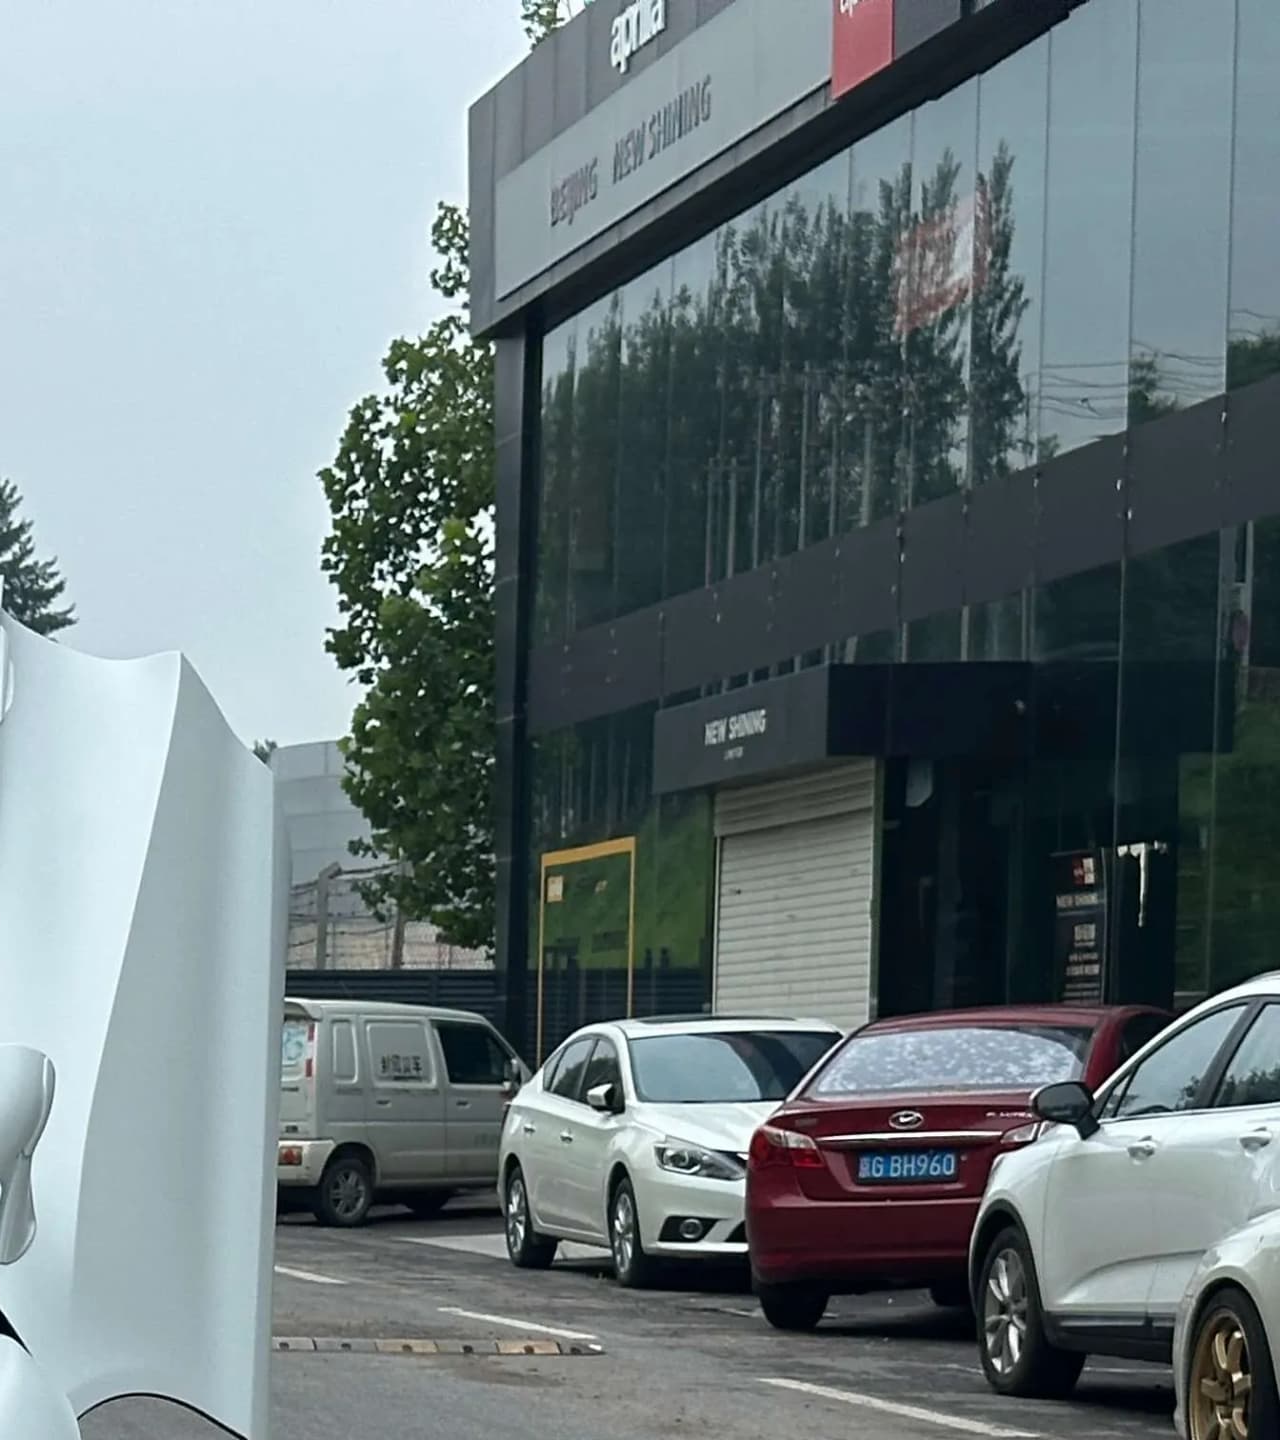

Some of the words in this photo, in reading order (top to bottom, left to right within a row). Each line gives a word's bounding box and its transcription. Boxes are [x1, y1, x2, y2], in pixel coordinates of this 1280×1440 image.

[613, 121, 646, 185] NEW
[648, 74, 711, 160] SHINING
[704, 717, 727, 746] NEW
[728, 708, 766, 740] SHINING
[890, 1153, 956, 1178] BH960
